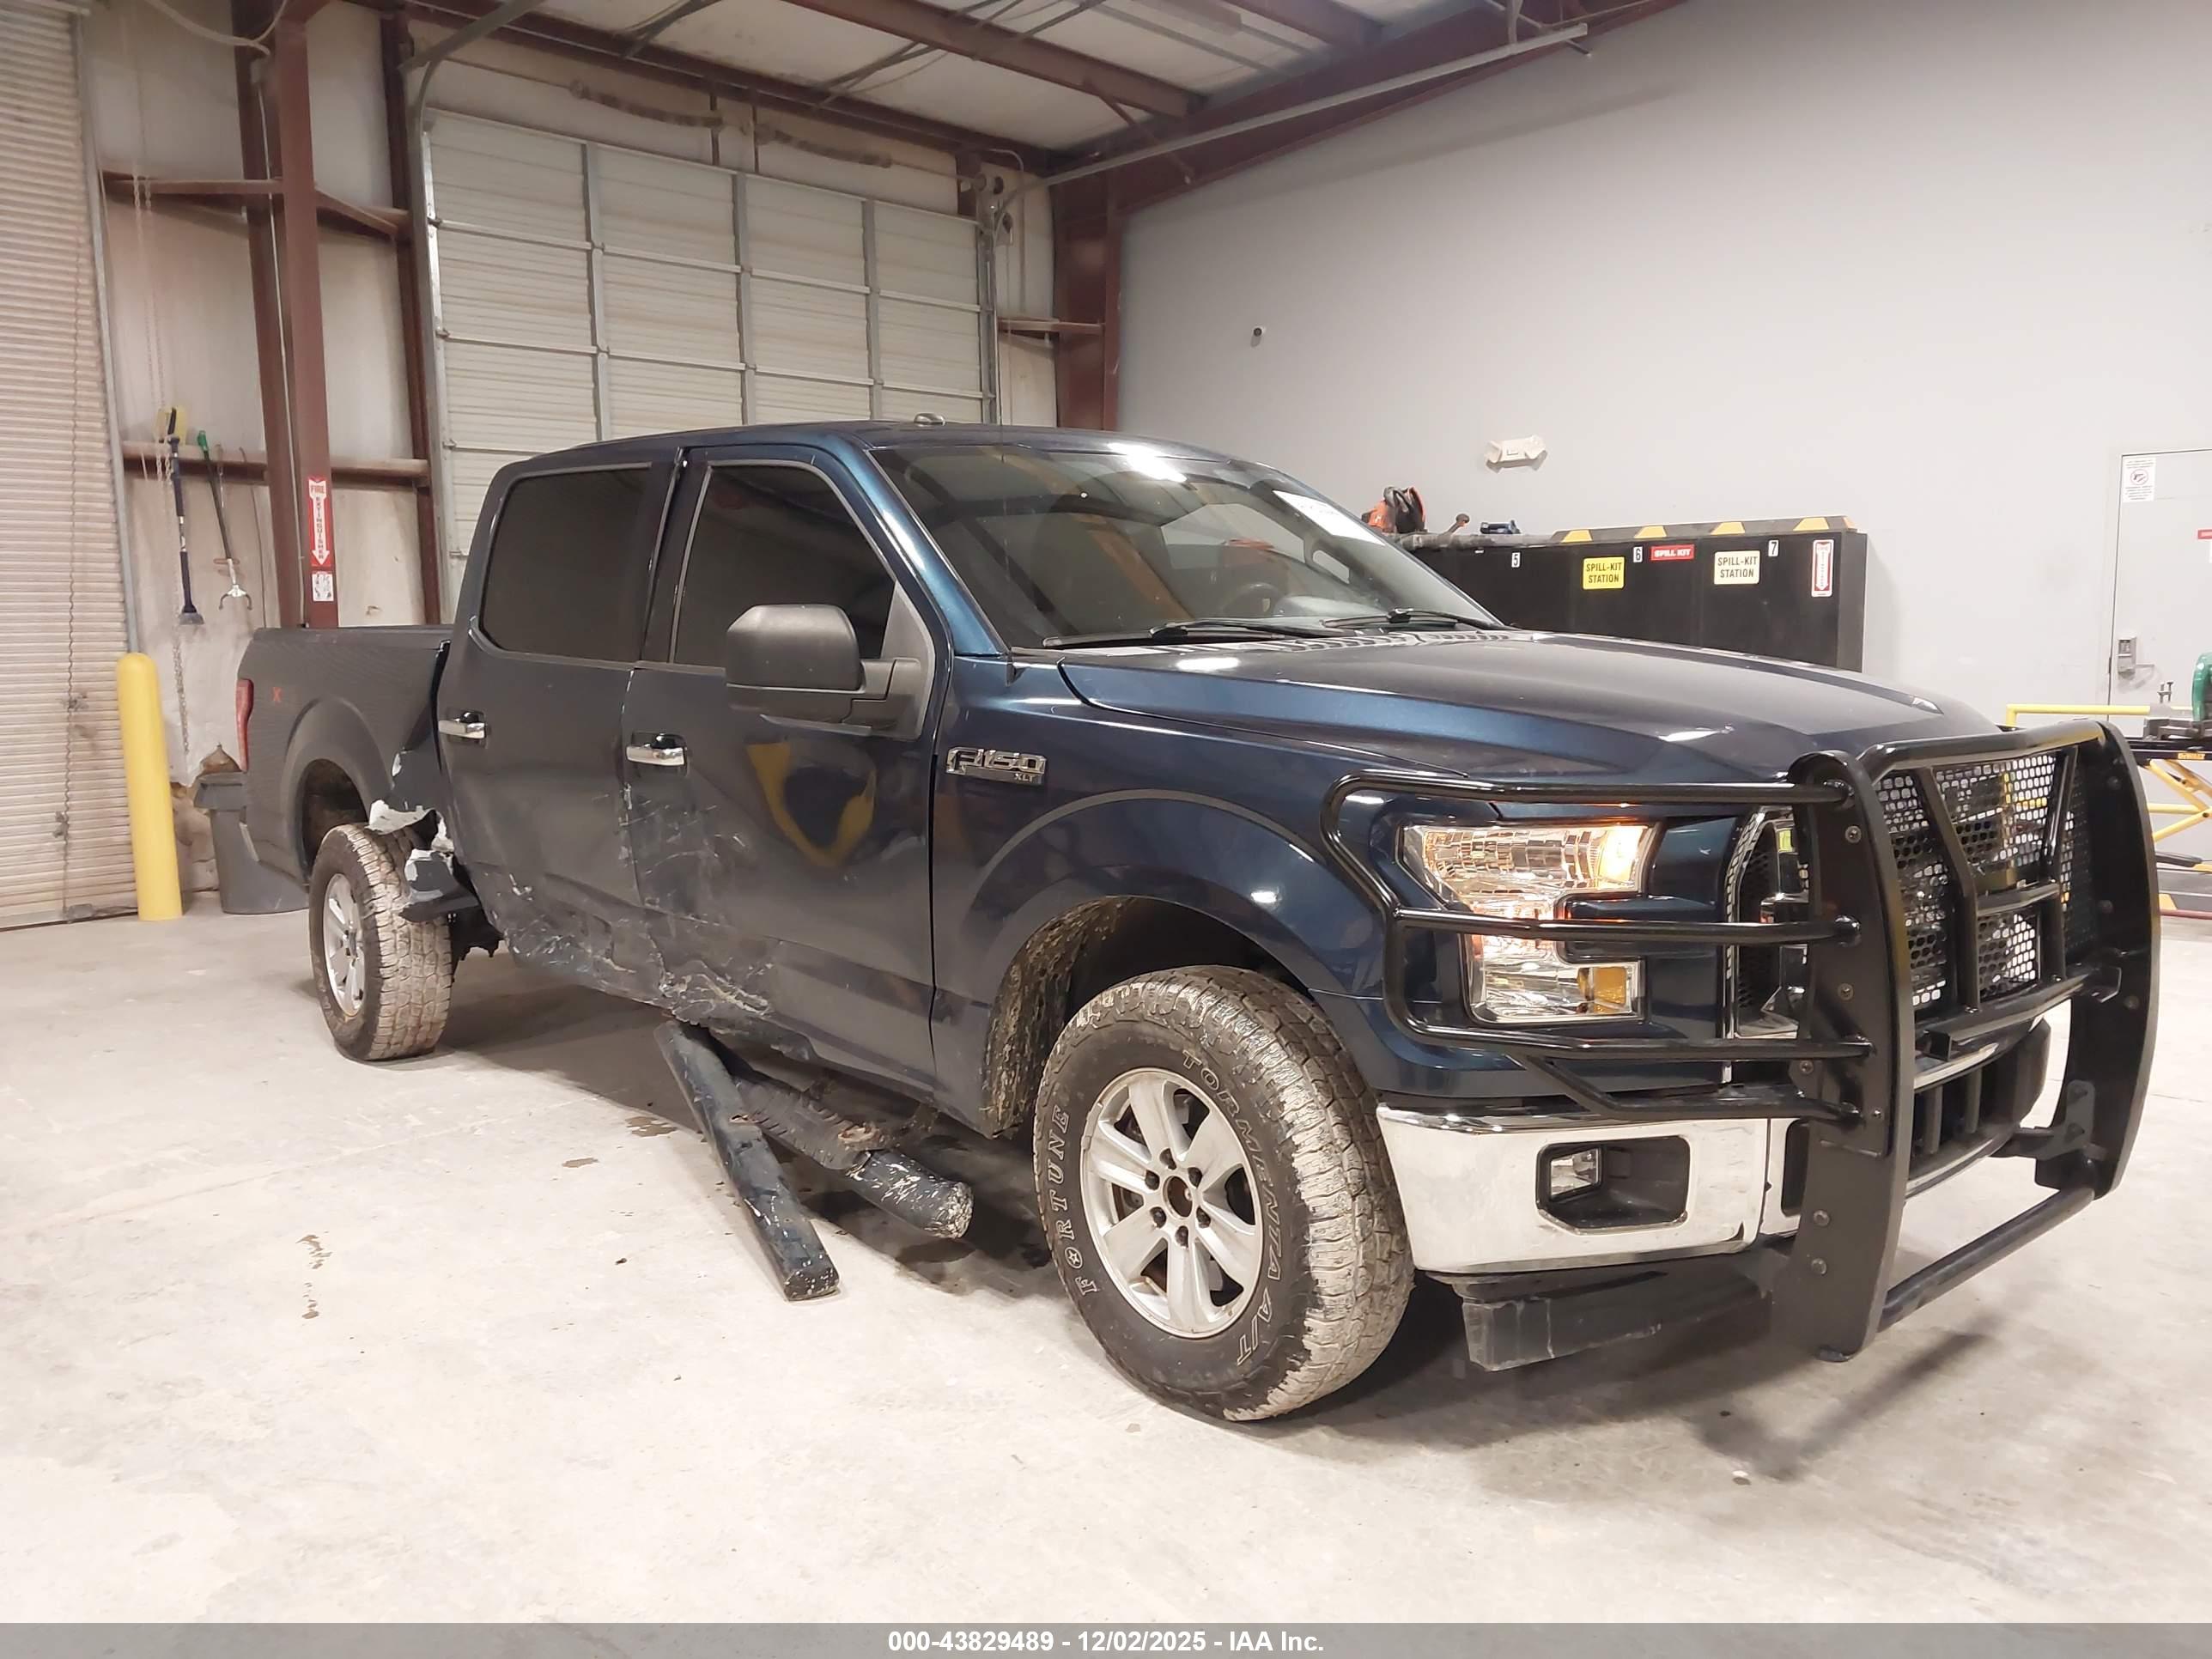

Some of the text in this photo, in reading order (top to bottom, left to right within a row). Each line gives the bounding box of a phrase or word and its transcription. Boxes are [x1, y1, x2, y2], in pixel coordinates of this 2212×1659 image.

[1654, 548, 1691, 558] SPILL KIT
[1771, 541, 1778, 556] 7
[1635, 548, 1641, 561] 6
[1717, 556, 1758, 566] SPILL-KIT
[1586, 562, 1622, 572] SPILL-KIT
[1720, 568, 1754, 578] STATION
[1588, 574, 1620, 584] STATION
[1014, 773, 1035, 782] XLT
[1046, 1104, 1099, 1296] FORTUNE
[1182, 1049, 1285, 1366] TORMENTA A/T
